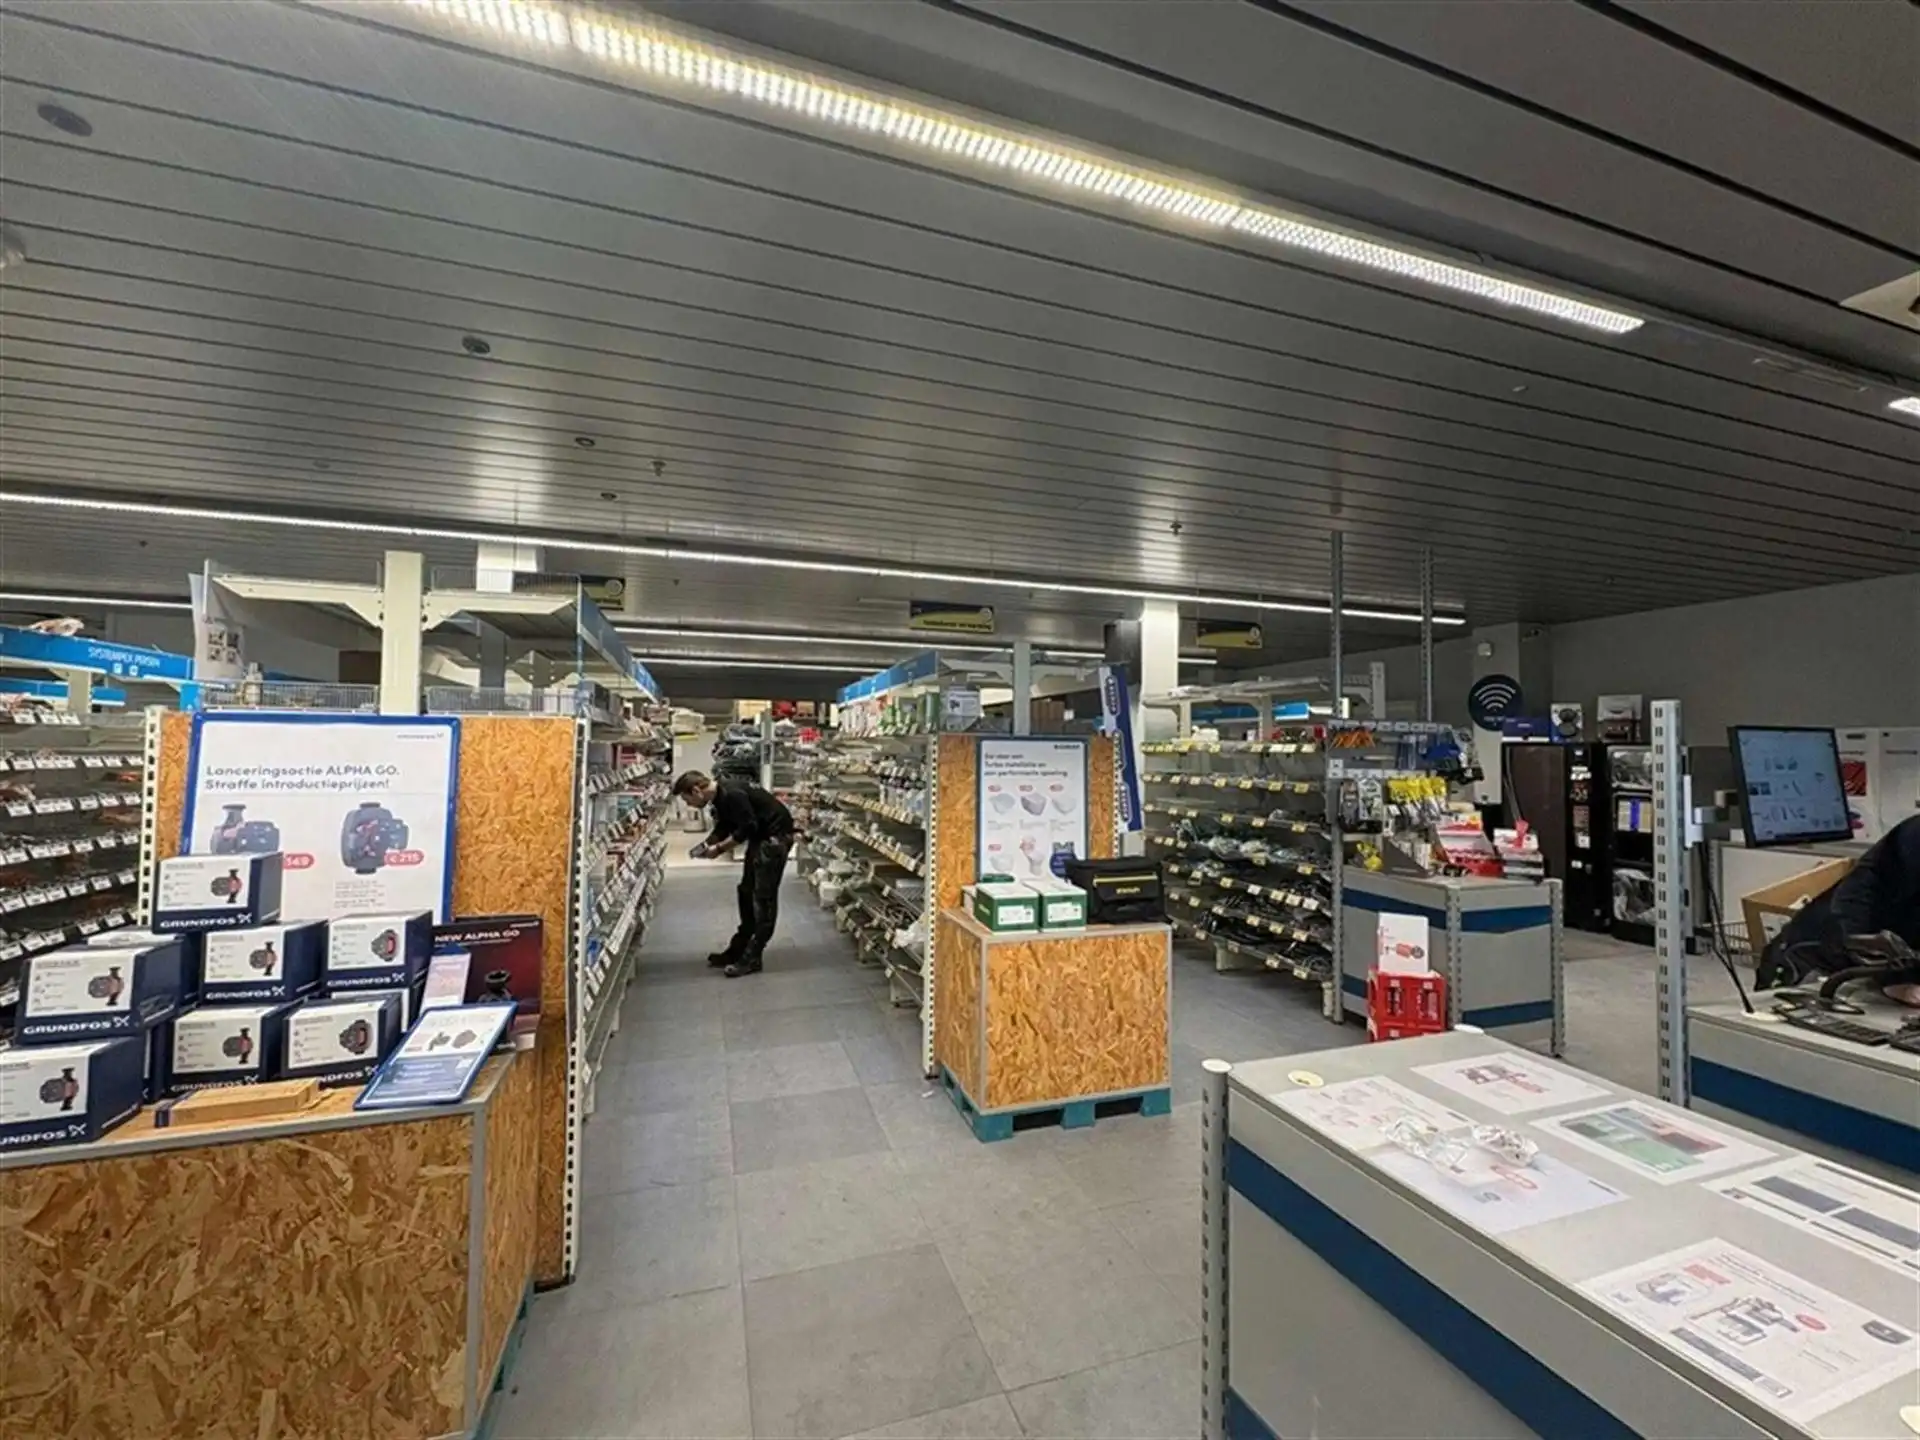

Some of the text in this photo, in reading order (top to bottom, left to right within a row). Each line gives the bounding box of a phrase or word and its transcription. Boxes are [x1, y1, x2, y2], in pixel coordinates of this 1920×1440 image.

[206, 765, 400, 778] Lanceringsactie ALPHA GO.
[205, 778, 390, 791] Straffe introductieprijzen!
[160, 917, 236, 929] GRUNDFOS
[434, 933, 463, 943] NEW
[464, 931, 501, 941] ALPHA
[502, 928, 520, 938] GO
[326, 976, 392, 988] GRUNDFOS
[206, 989, 271, 1001] GRUNDFOS
[23, 1020, 112, 1035] GRUNDFOS
